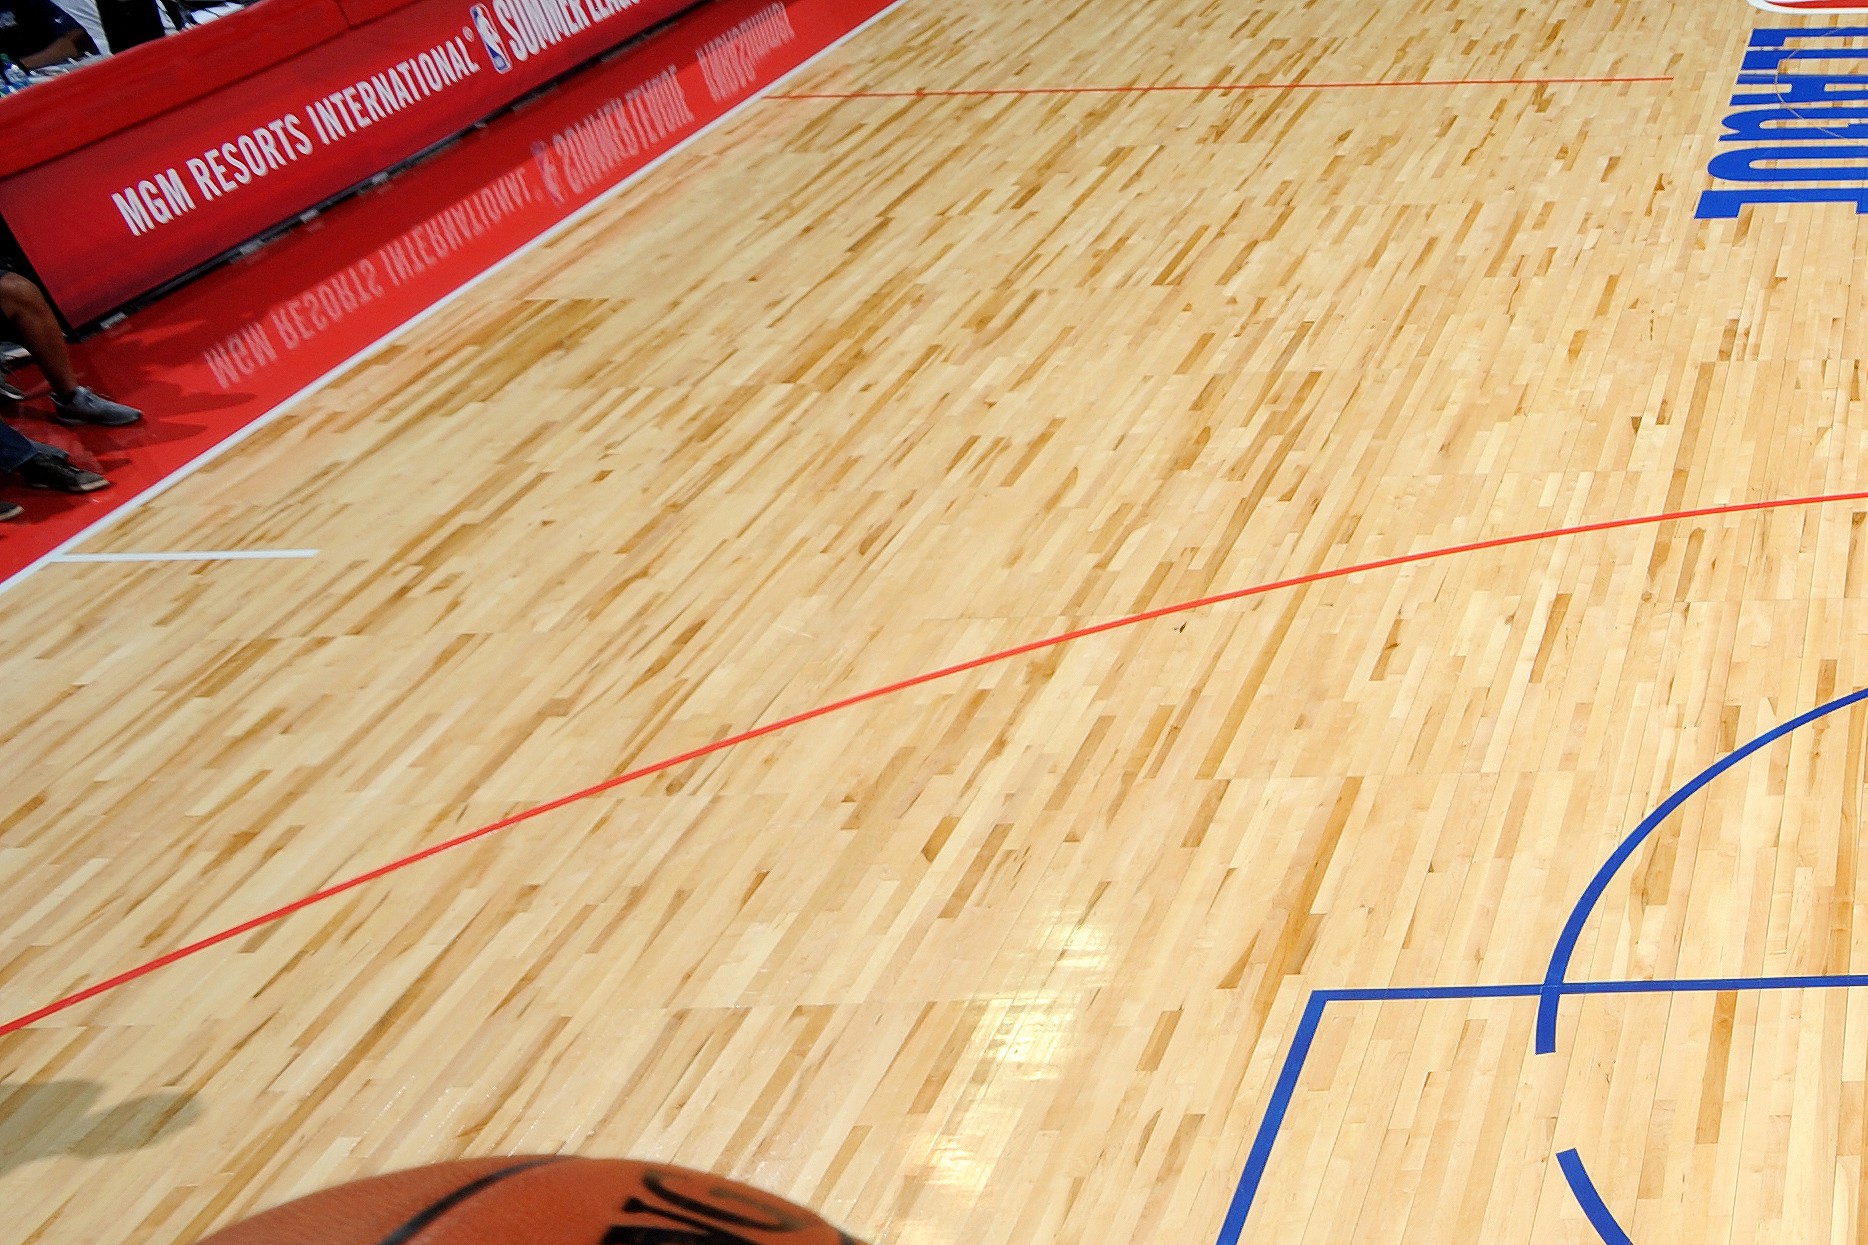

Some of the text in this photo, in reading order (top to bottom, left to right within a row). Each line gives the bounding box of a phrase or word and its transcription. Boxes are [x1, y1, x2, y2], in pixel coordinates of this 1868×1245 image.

[111, 36, 481, 237] MGM RESORTS INTERNATIONAL
